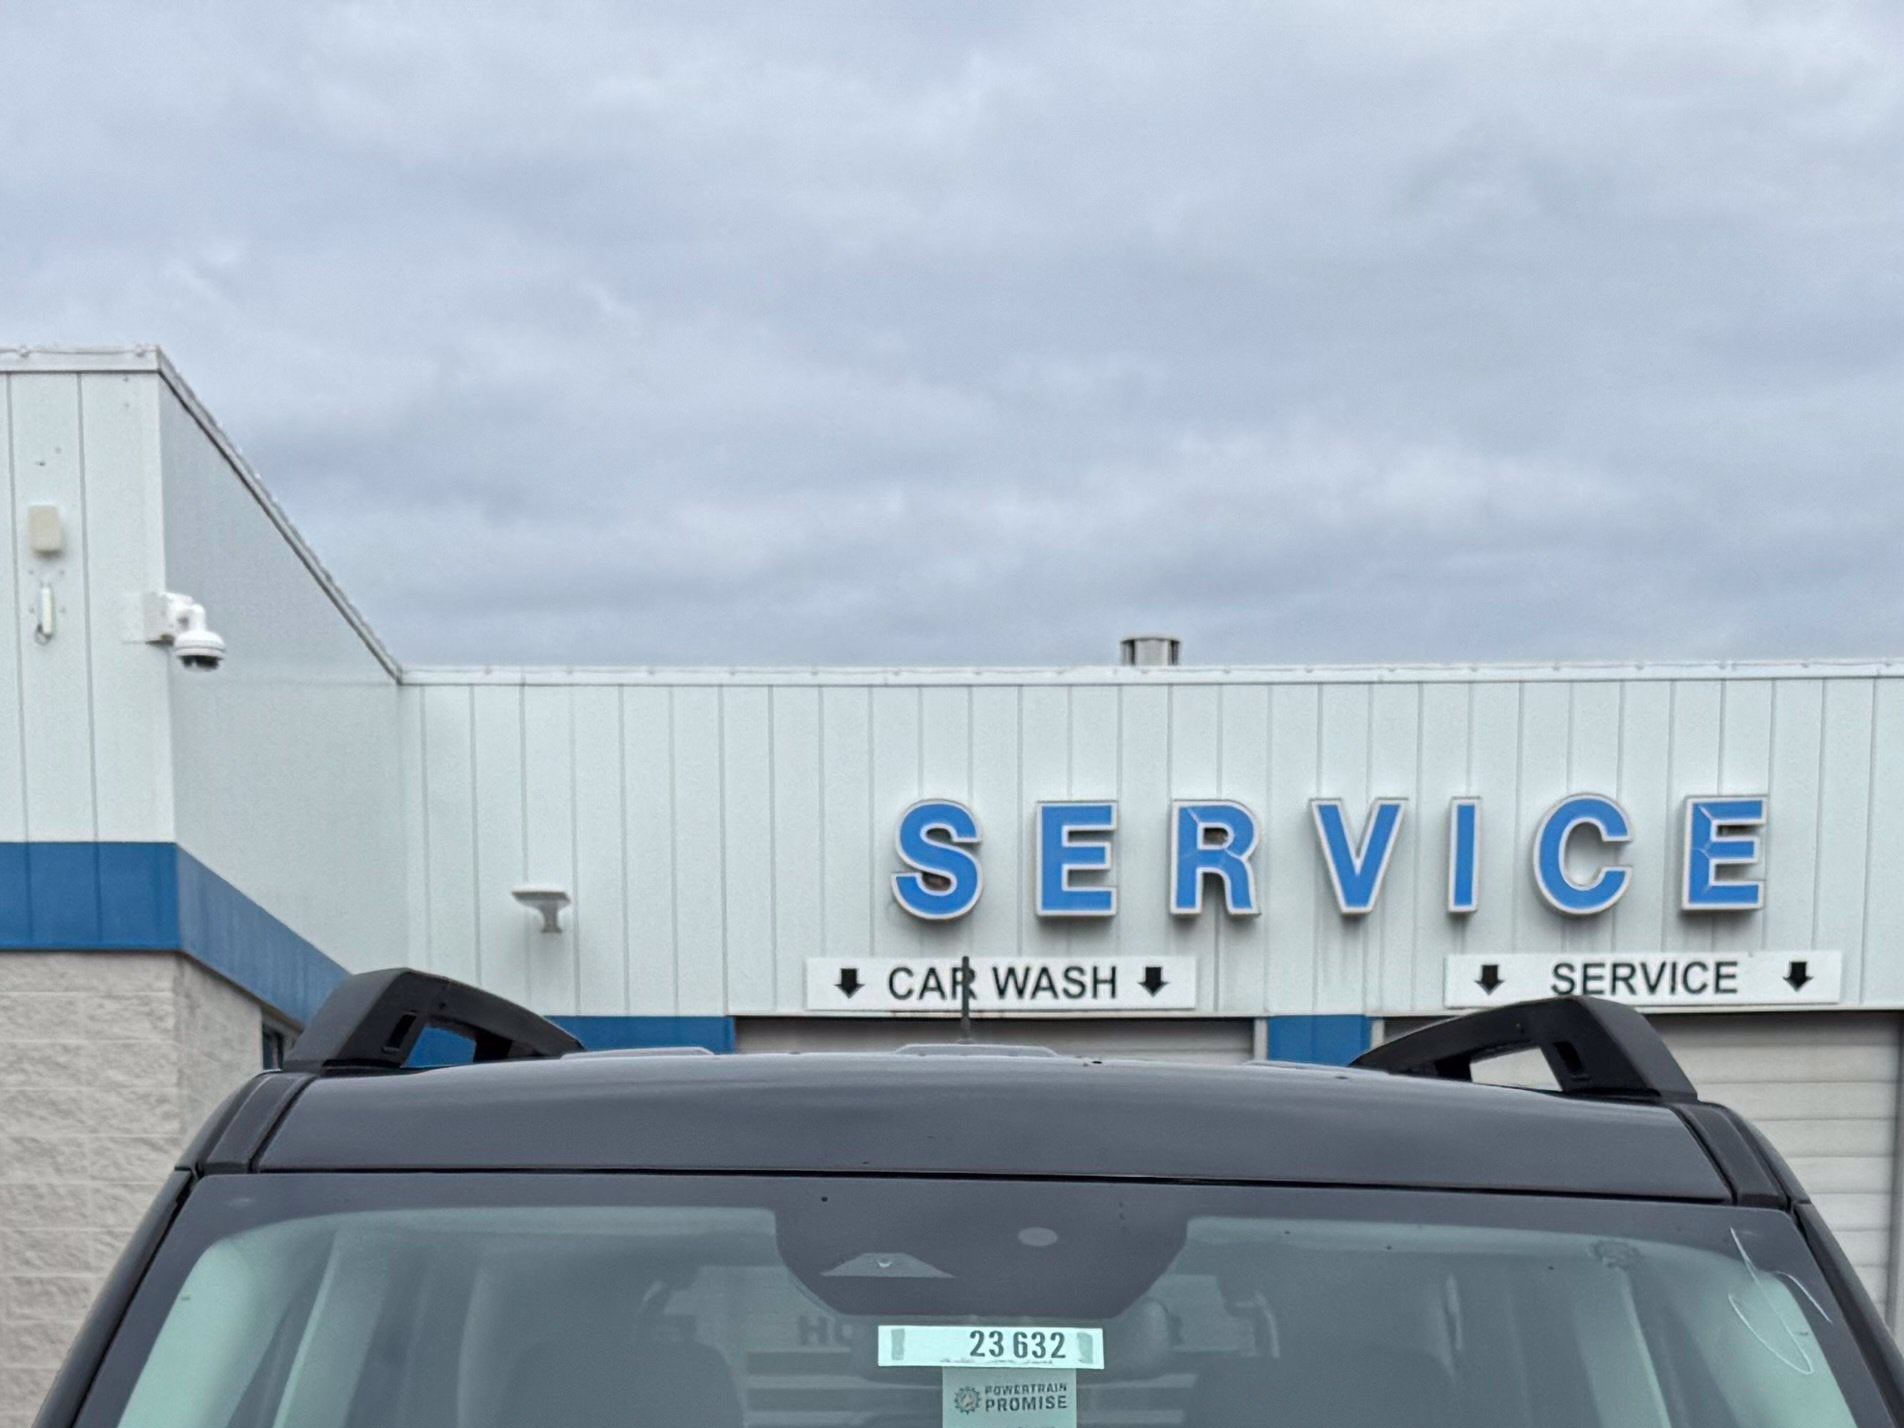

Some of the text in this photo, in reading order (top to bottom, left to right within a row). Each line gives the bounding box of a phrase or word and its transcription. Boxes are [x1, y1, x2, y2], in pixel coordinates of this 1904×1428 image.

[891, 793, 1768, 922] SERVICE
[888, 965, 1117, 1001] CAR WASH
[1550, 961, 1738, 996] SERVICE
[984, 1382, 1068, 1396] POWERTRAIN
[984, 1395, 1068, 1412] PROMISE
